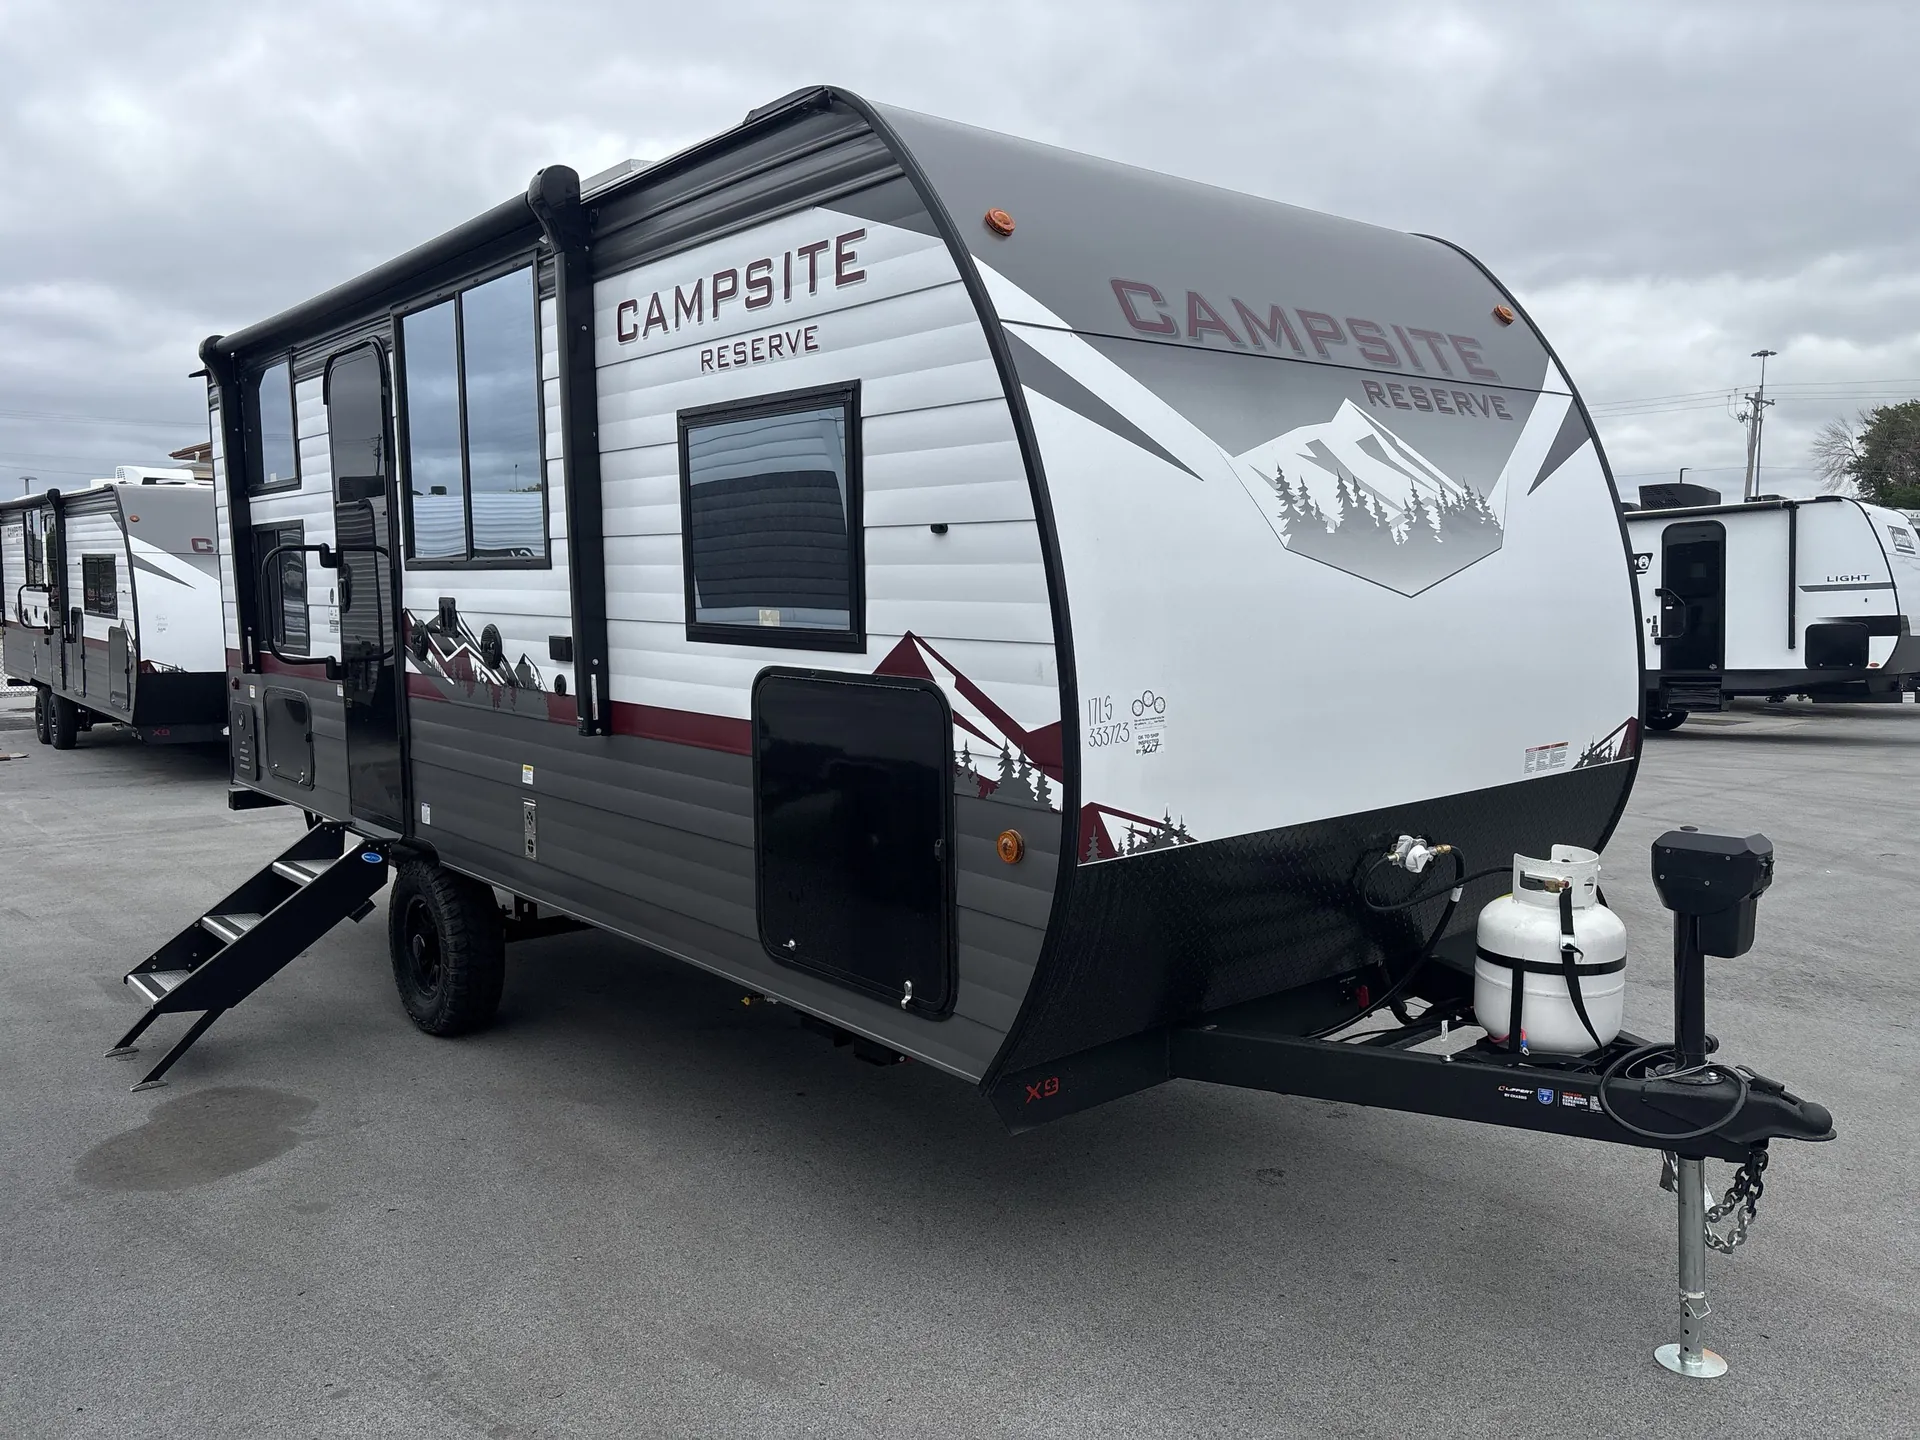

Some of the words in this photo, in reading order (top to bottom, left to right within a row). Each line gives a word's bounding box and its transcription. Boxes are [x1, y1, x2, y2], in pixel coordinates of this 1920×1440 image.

[617, 228, 866, 343] CAMPSITE
[701, 325, 819, 373] RESERVE
[1110, 279, 1501, 382] CAMPSITE
[1361, 379, 1514, 421] RESERVE
[1826, 574, 1871, 583] LIGHT
[1088, 722, 1130, 748] 333723
[1025, 1077, 1059, 1104] X9
